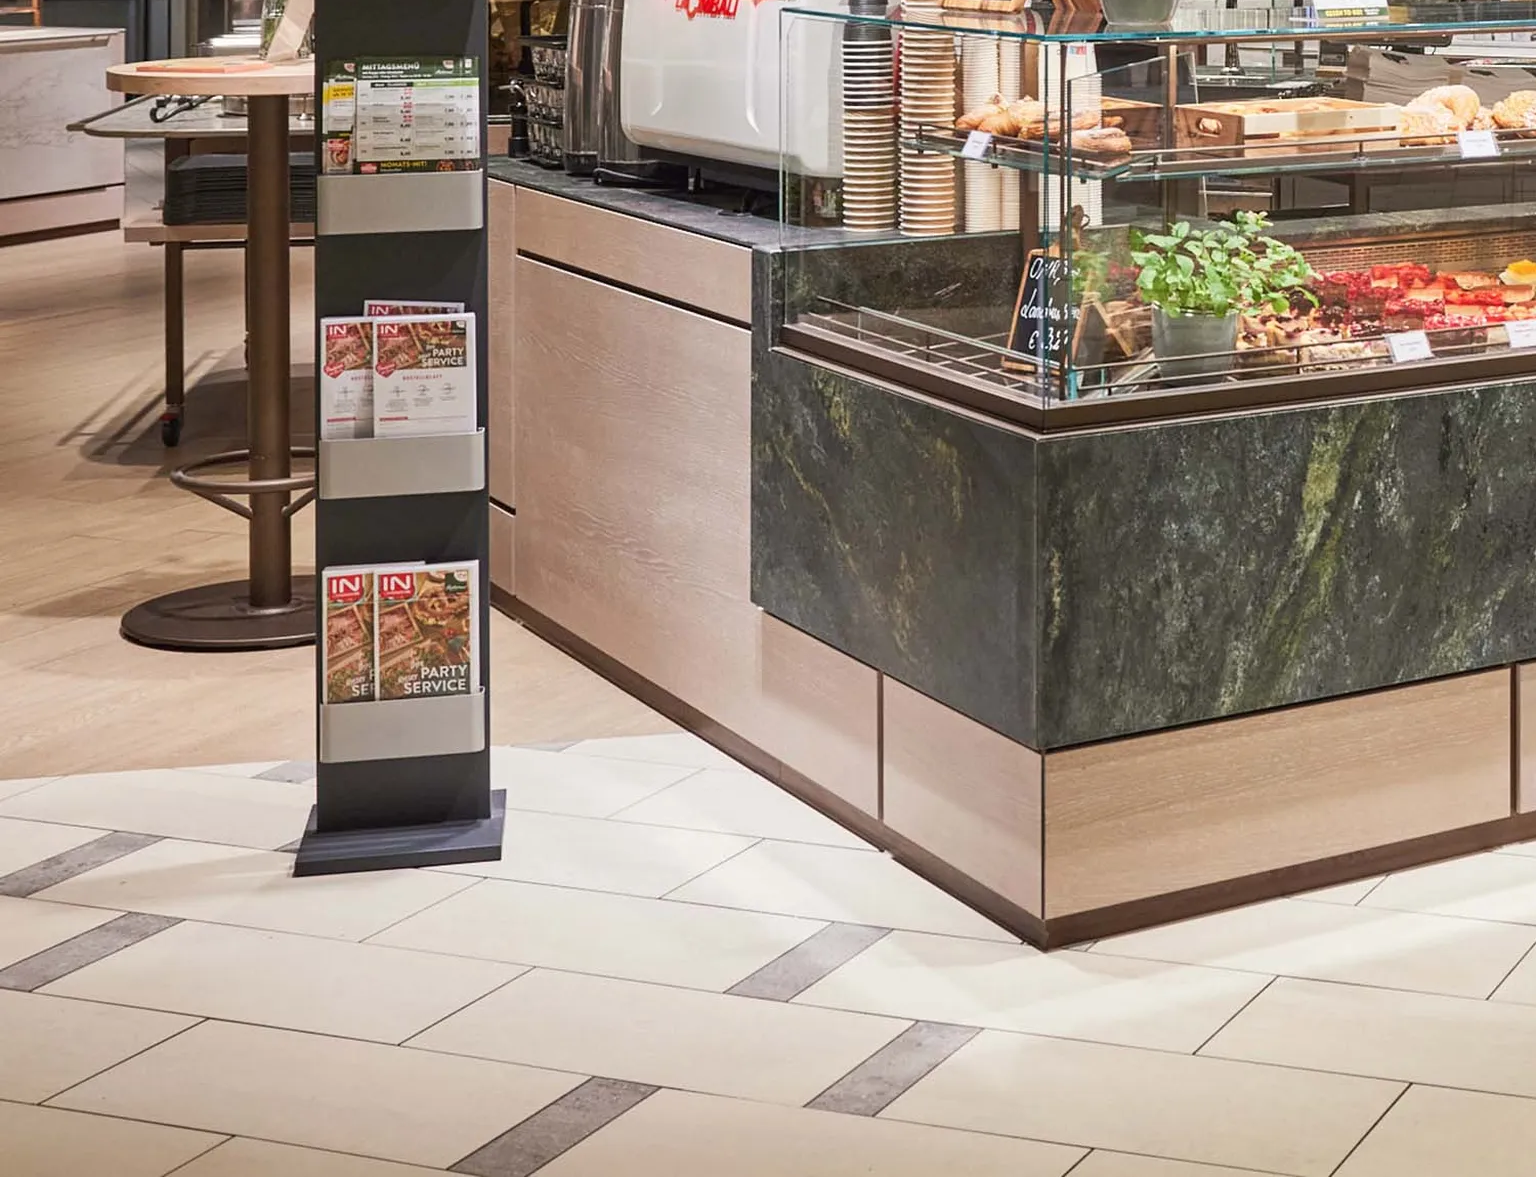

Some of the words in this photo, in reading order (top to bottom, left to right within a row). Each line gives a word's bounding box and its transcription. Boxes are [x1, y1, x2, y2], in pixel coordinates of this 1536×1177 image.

[371, 306, 389, 315] IN
[329, 325, 347, 335] IN
[380, 324, 399, 334] IN
[432, 347, 464, 357] PARTY
[422, 357, 464, 367] SERVICE
[331, 576, 360, 594] IN
[382, 574, 411, 591] IN
[421, 664, 467, 679] PARTY
[404, 679, 466, 695] SERVICE
